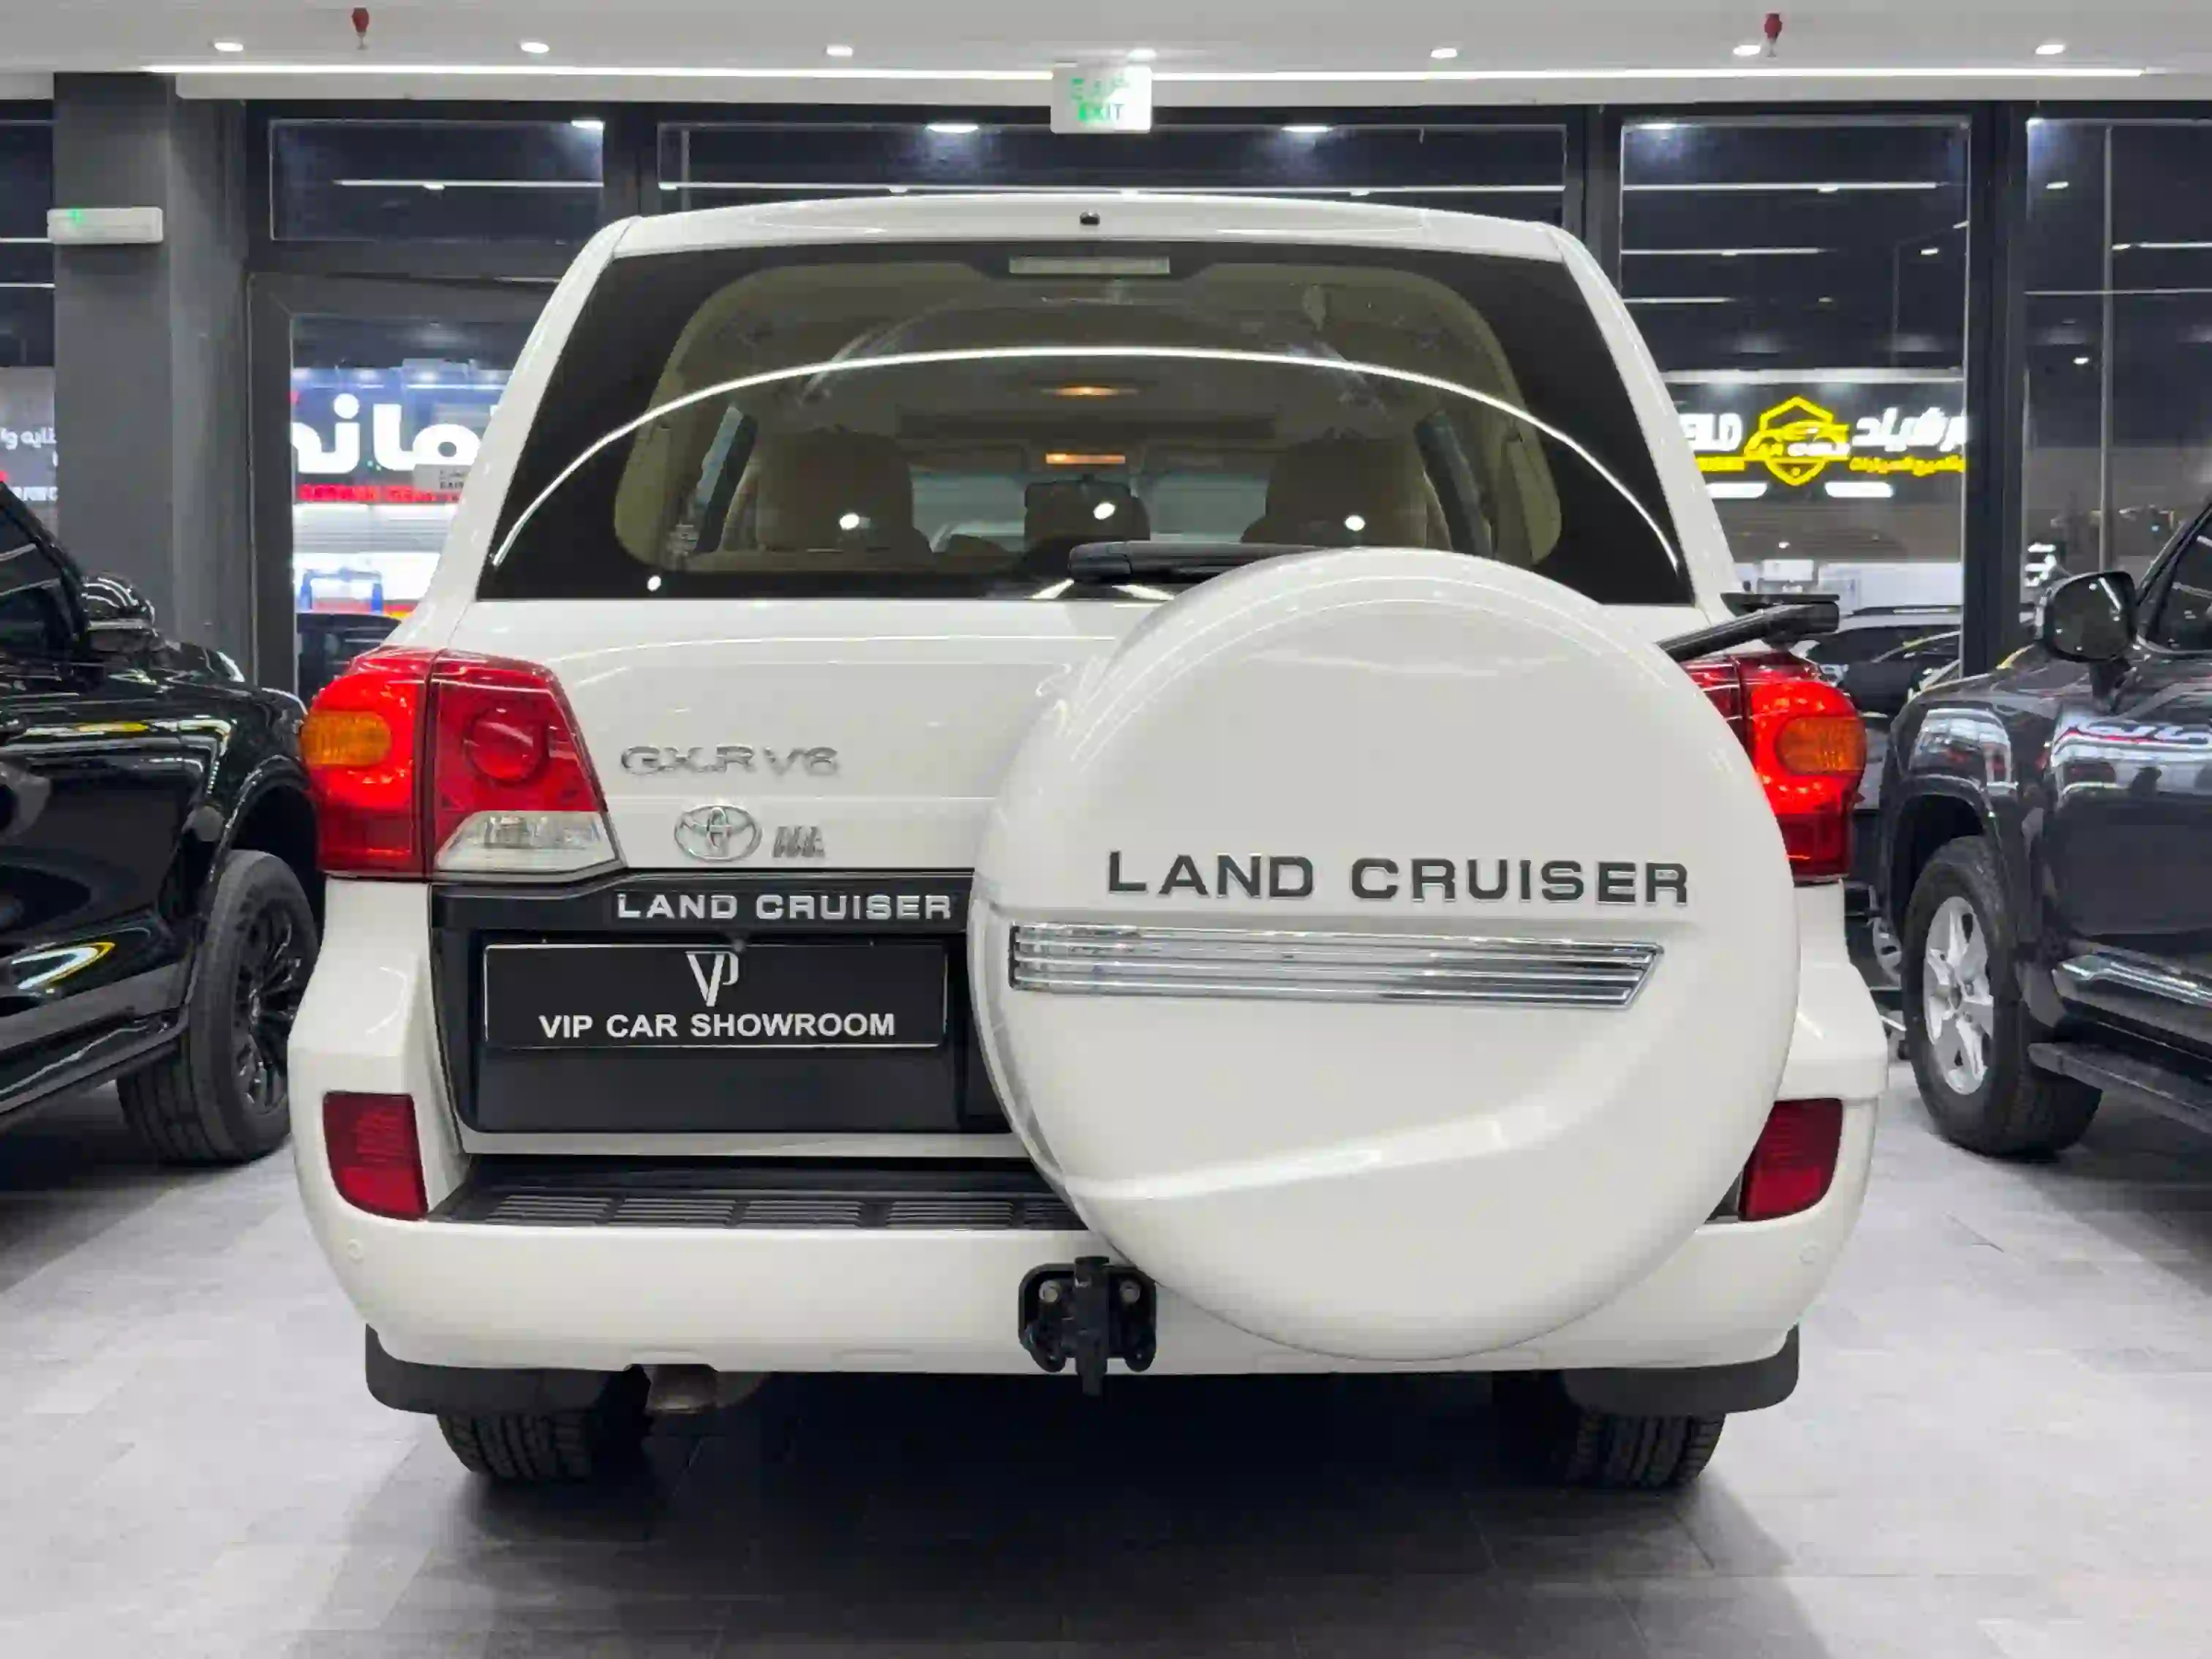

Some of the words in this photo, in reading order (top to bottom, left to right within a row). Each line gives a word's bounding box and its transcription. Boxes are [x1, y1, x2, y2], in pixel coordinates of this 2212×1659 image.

[1107, 849, 1316, 900] LAND
[1349, 857, 1688, 906] CRUISER
[616, 893, 738, 920] LAND
[755, 894, 952, 920] CRUISER
[538, 1014, 593, 1039] VIP
[606, 1013, 679, 1039] CAR
[689, 1012, 896, 1038] SHOWROOM
